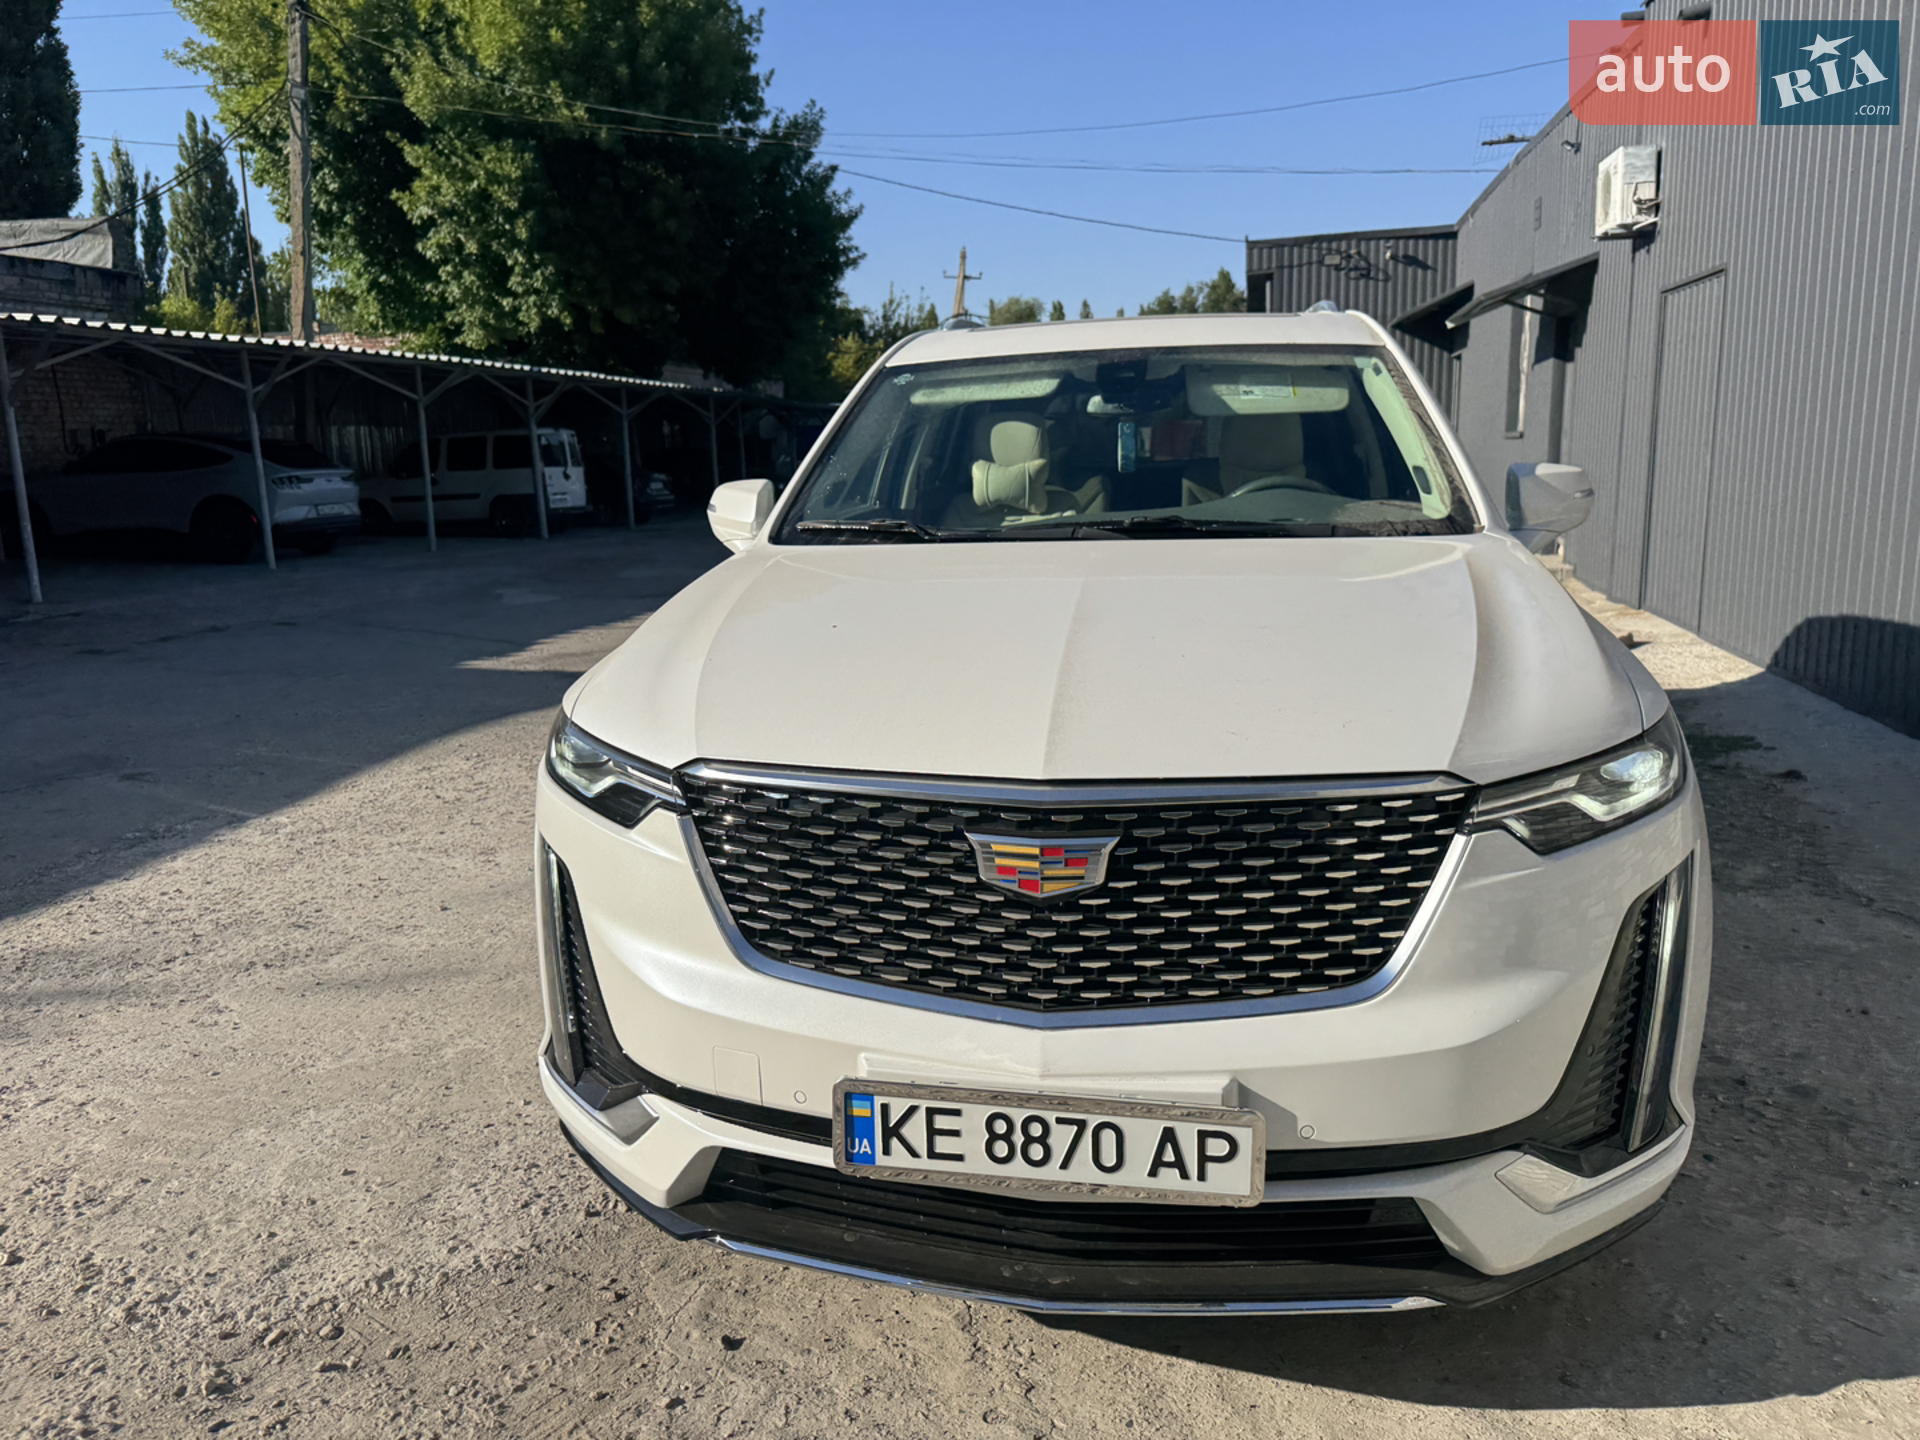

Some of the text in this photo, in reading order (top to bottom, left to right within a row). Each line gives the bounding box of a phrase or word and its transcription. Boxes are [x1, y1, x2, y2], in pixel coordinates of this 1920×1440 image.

[847, 1137, 872, 1155] UA
[880, 1102, 1239, 1182] KE 8870 AP
